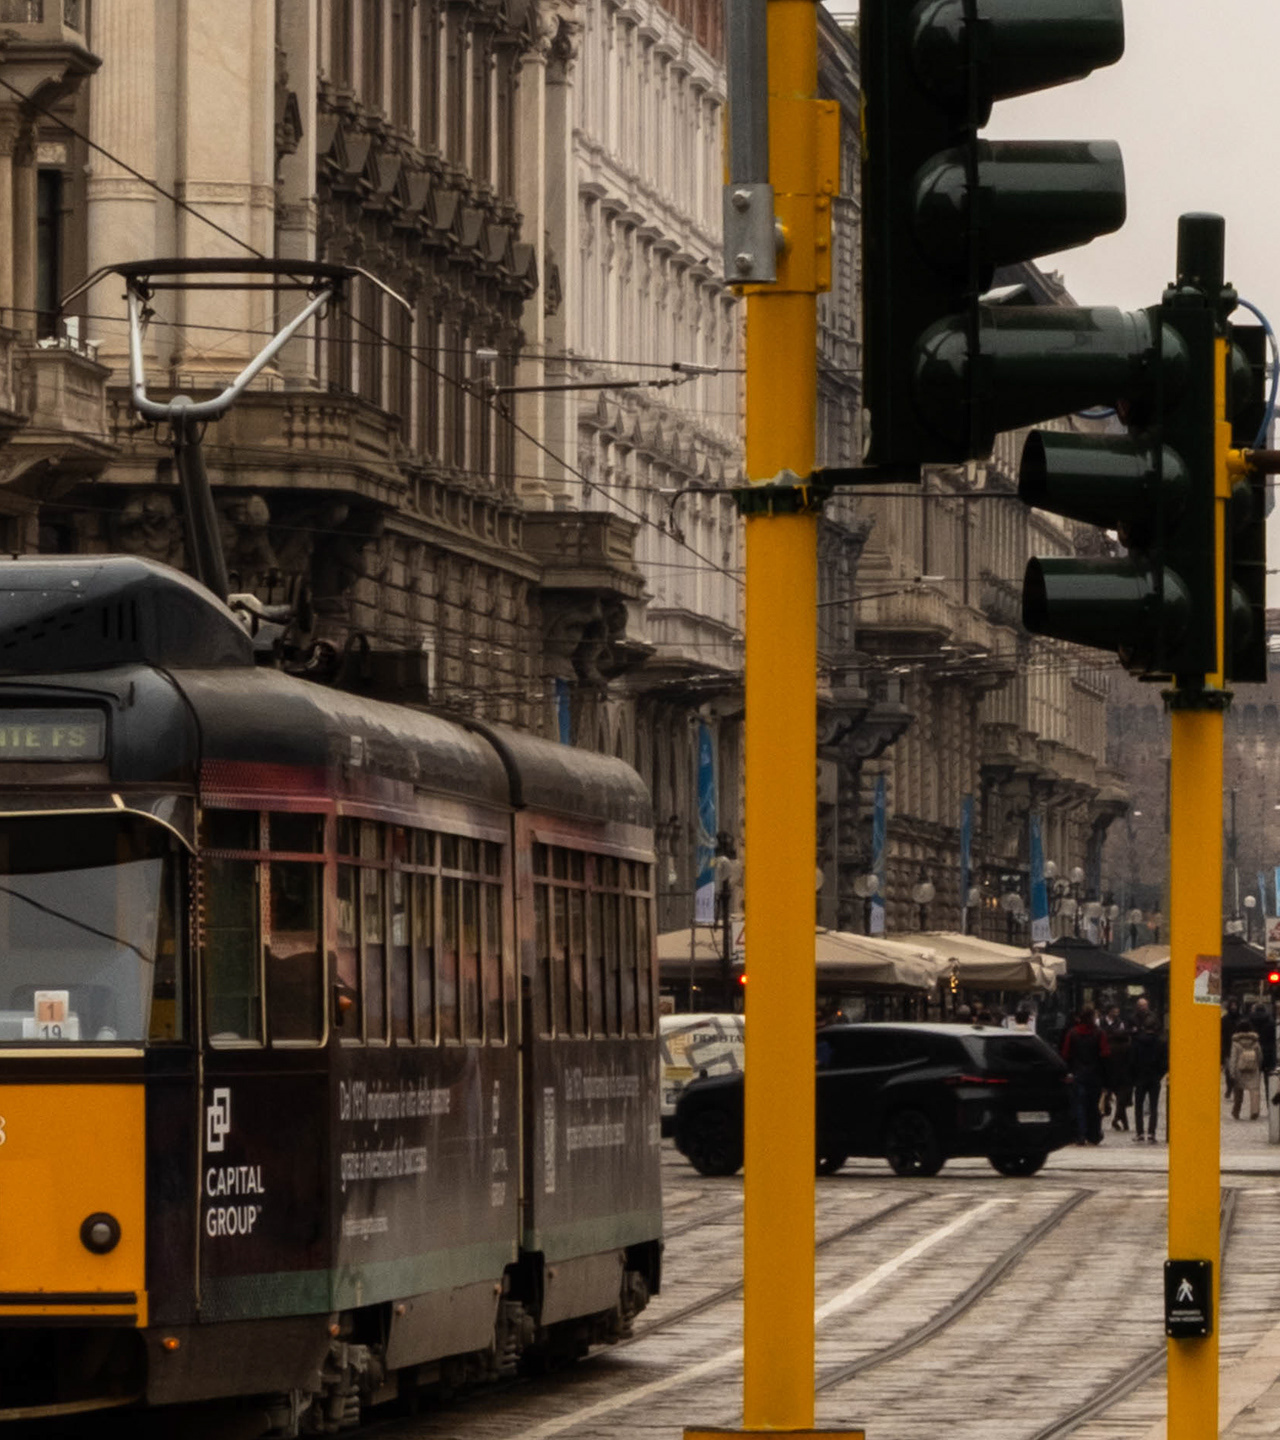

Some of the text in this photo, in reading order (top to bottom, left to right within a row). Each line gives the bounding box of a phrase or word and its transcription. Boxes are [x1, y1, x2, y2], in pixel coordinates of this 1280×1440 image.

[52, 726, 86, 748] FS
[41, 1024, 62, 1040] 19
[206, 1164, 265, 1197] CAPITAL
